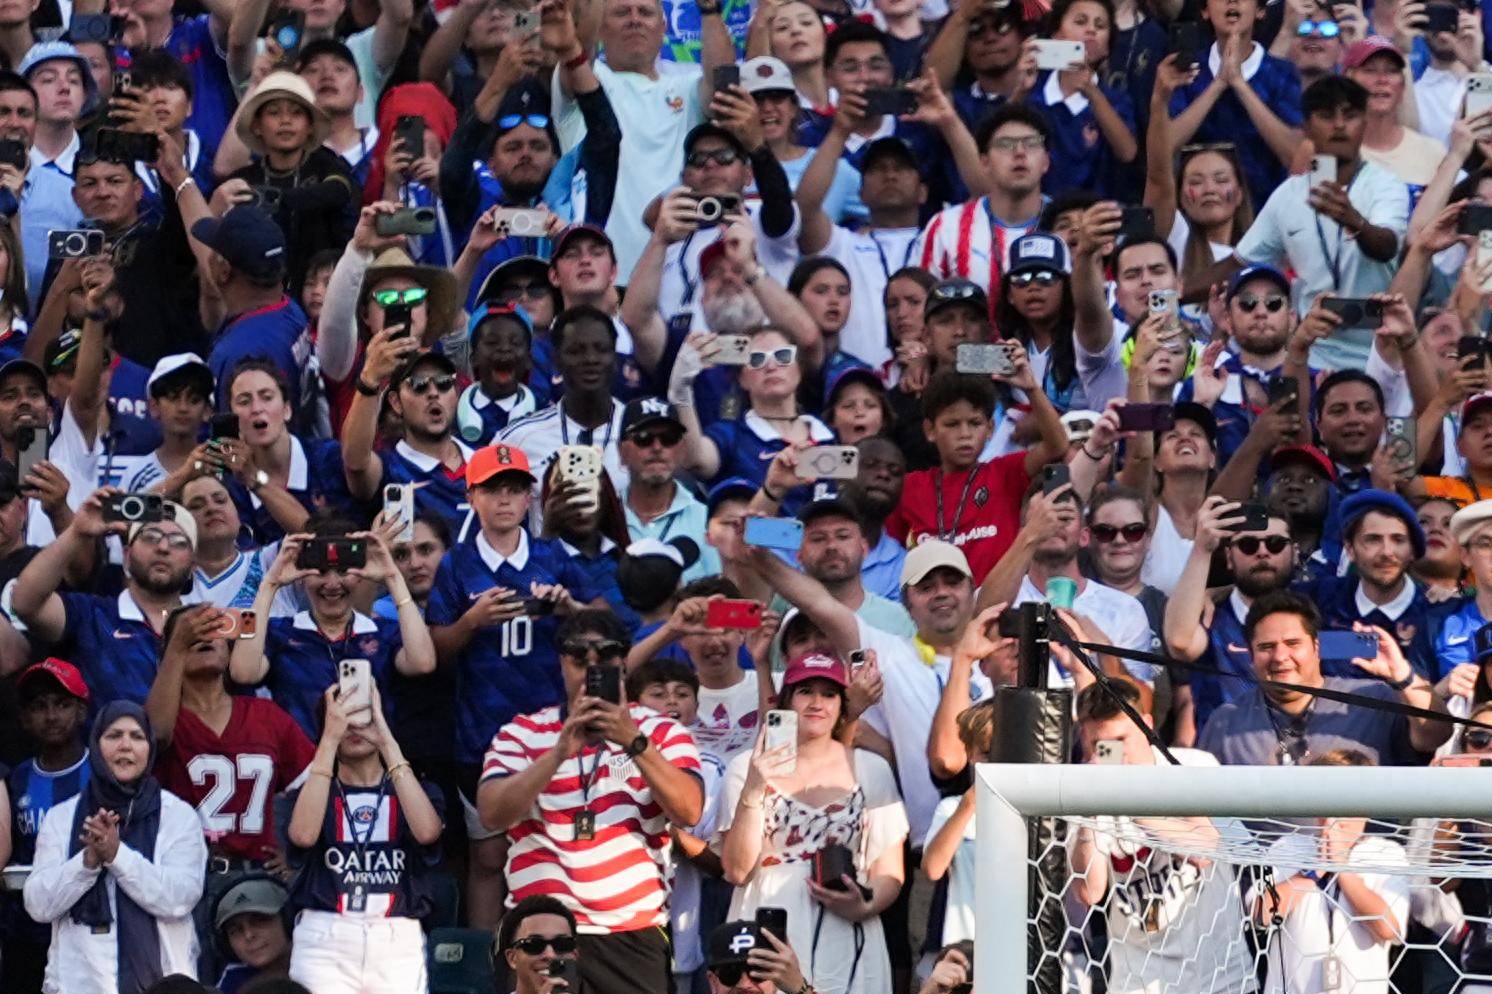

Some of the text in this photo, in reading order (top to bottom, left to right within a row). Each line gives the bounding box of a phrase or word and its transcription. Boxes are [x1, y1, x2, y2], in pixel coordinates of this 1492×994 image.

[456, 503, 475, 543] 7
[501, 615, 533, 658] 10
[187, 754, 274, 834] 27
[325, 847, 406, 874] QATAR
